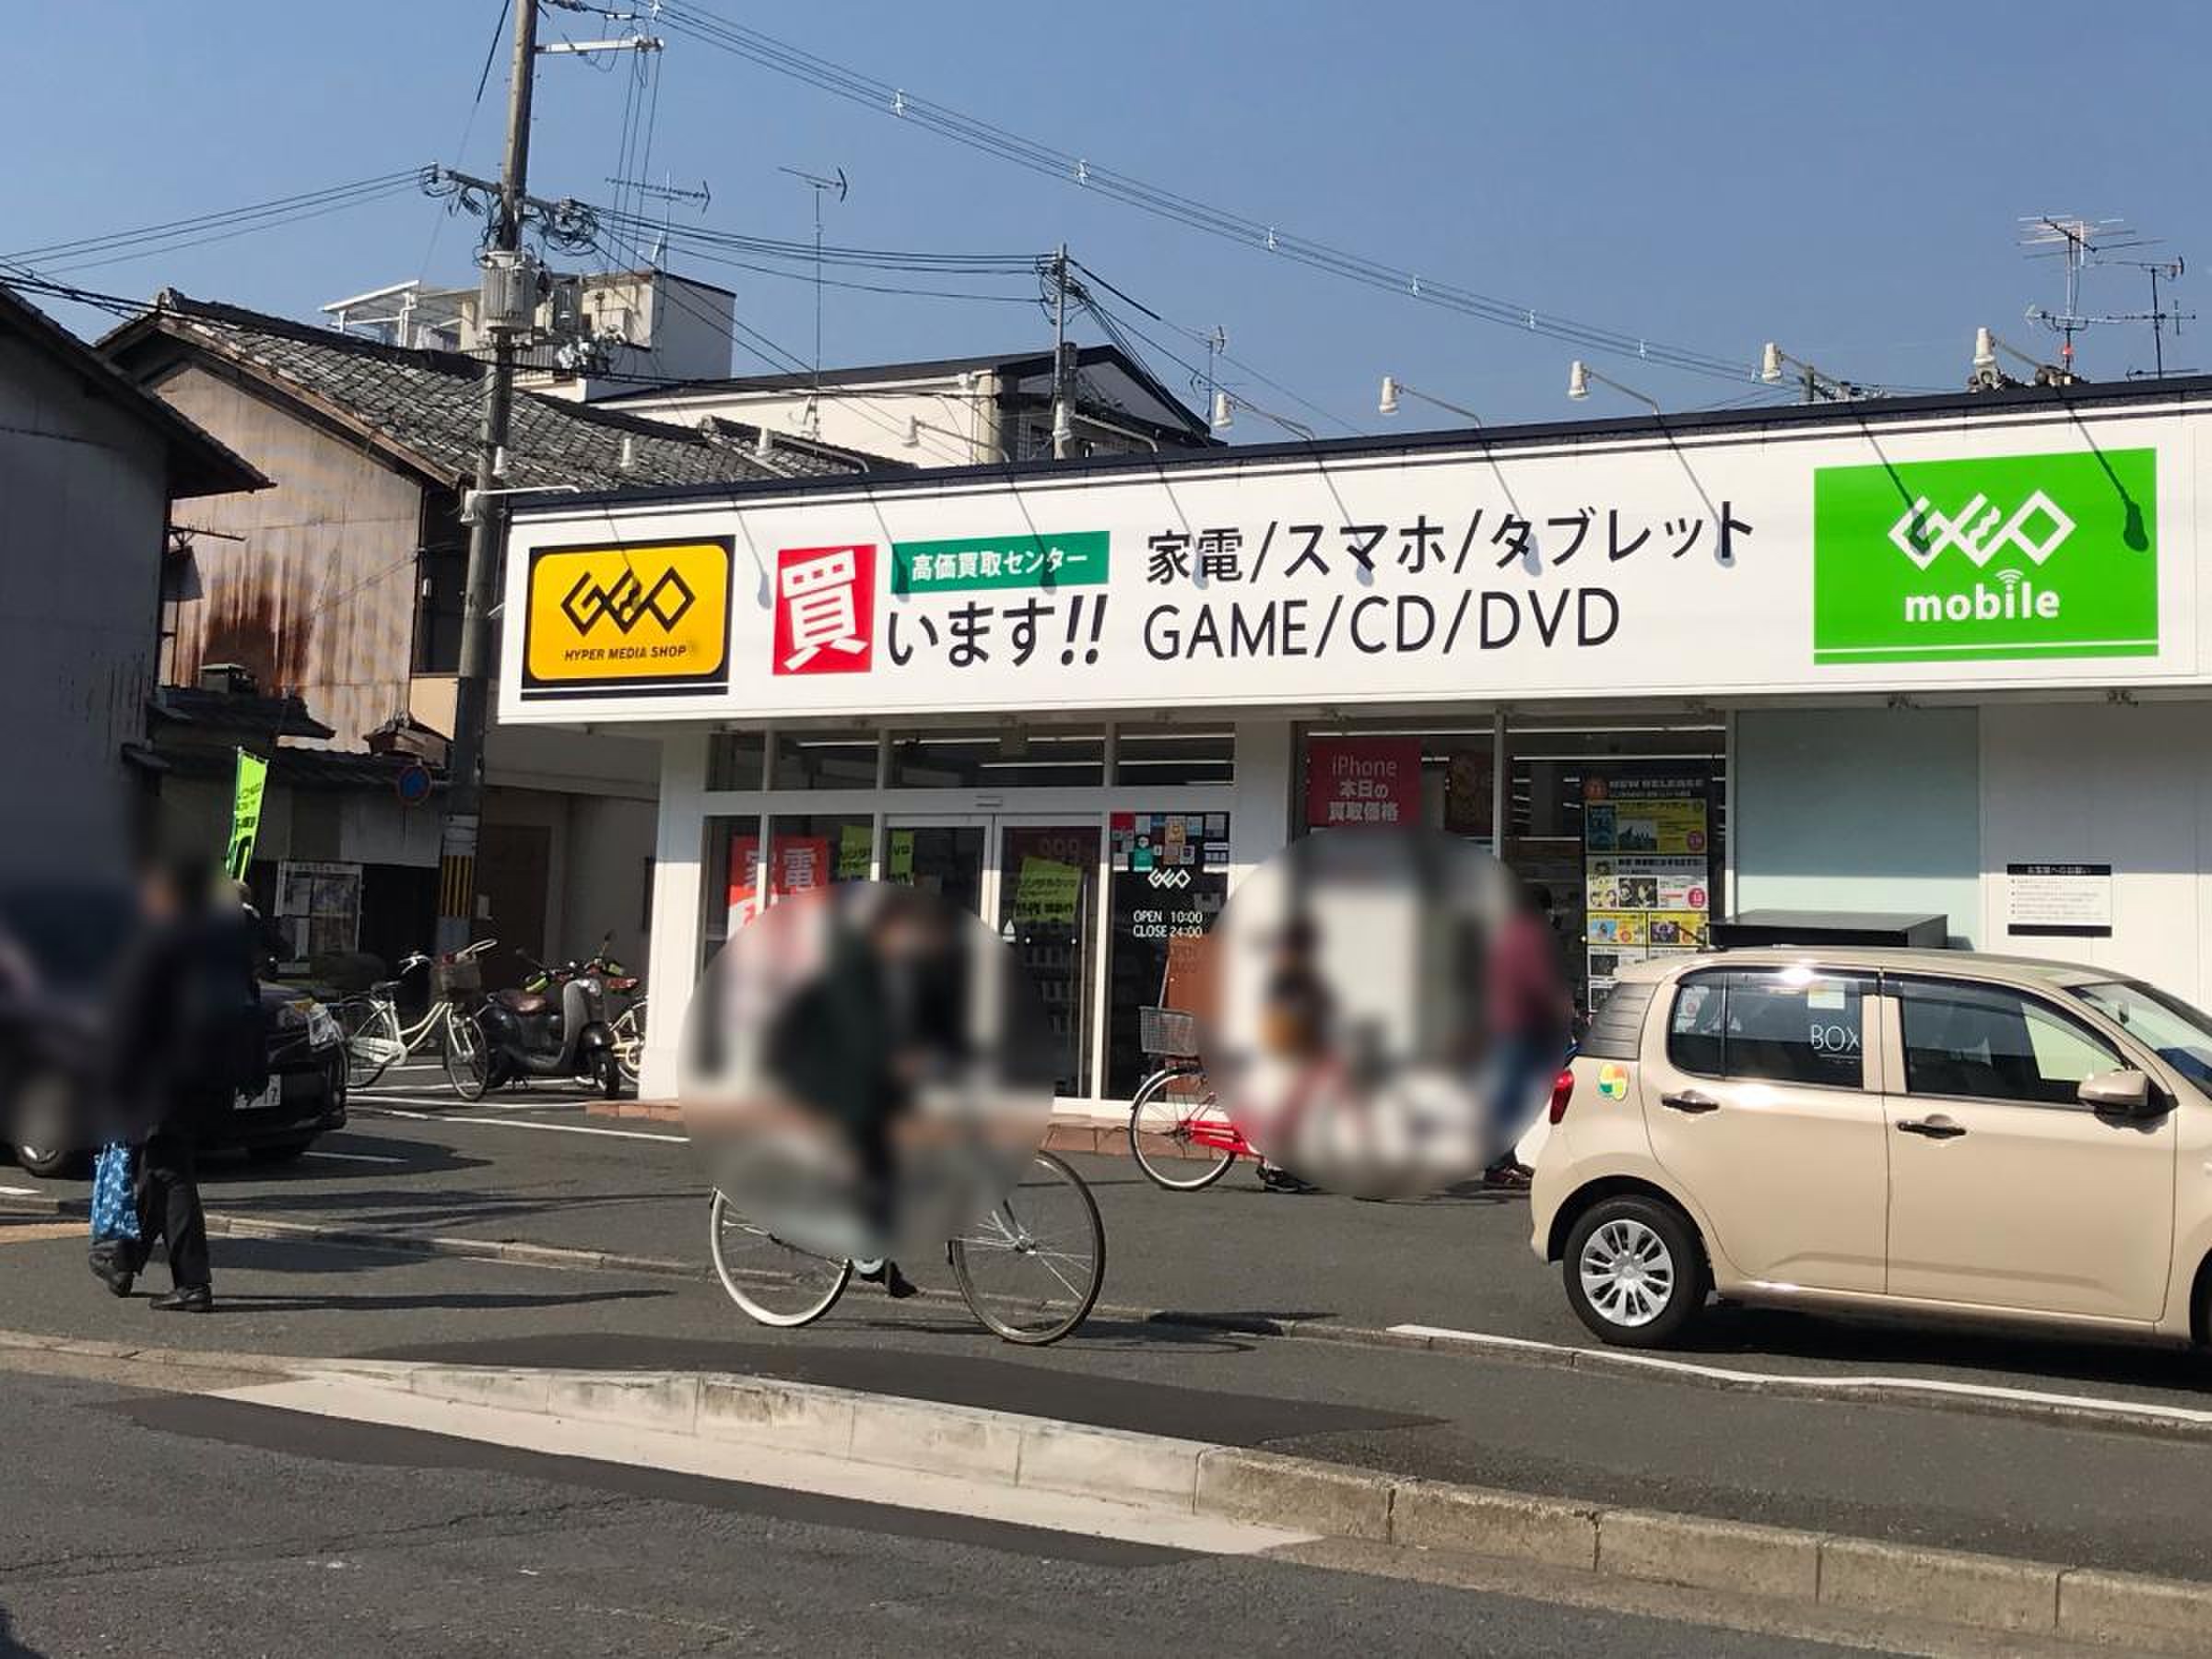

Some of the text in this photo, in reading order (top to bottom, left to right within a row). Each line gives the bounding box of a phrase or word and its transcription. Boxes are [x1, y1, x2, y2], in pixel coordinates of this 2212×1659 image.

[912, 547, 1088, 582] 高価買取センター
[560, 566, 696, 637] GEO
[1904, 577, 2061, 622] mobile
[564, 645, 688, 662] HYPER MEDIA SHOP
[1332, 755, 1398, 777] iPhone
[1339, 779, 1389, 799] 本日の
[1148, 868, 1192, 888] GEO
[1133, 910, 1204, 924] OPEN 10:00
[1133, 924, 1204, 938] CLOSE 24:00
[1810, 1023, 1861, 1052] BOX
